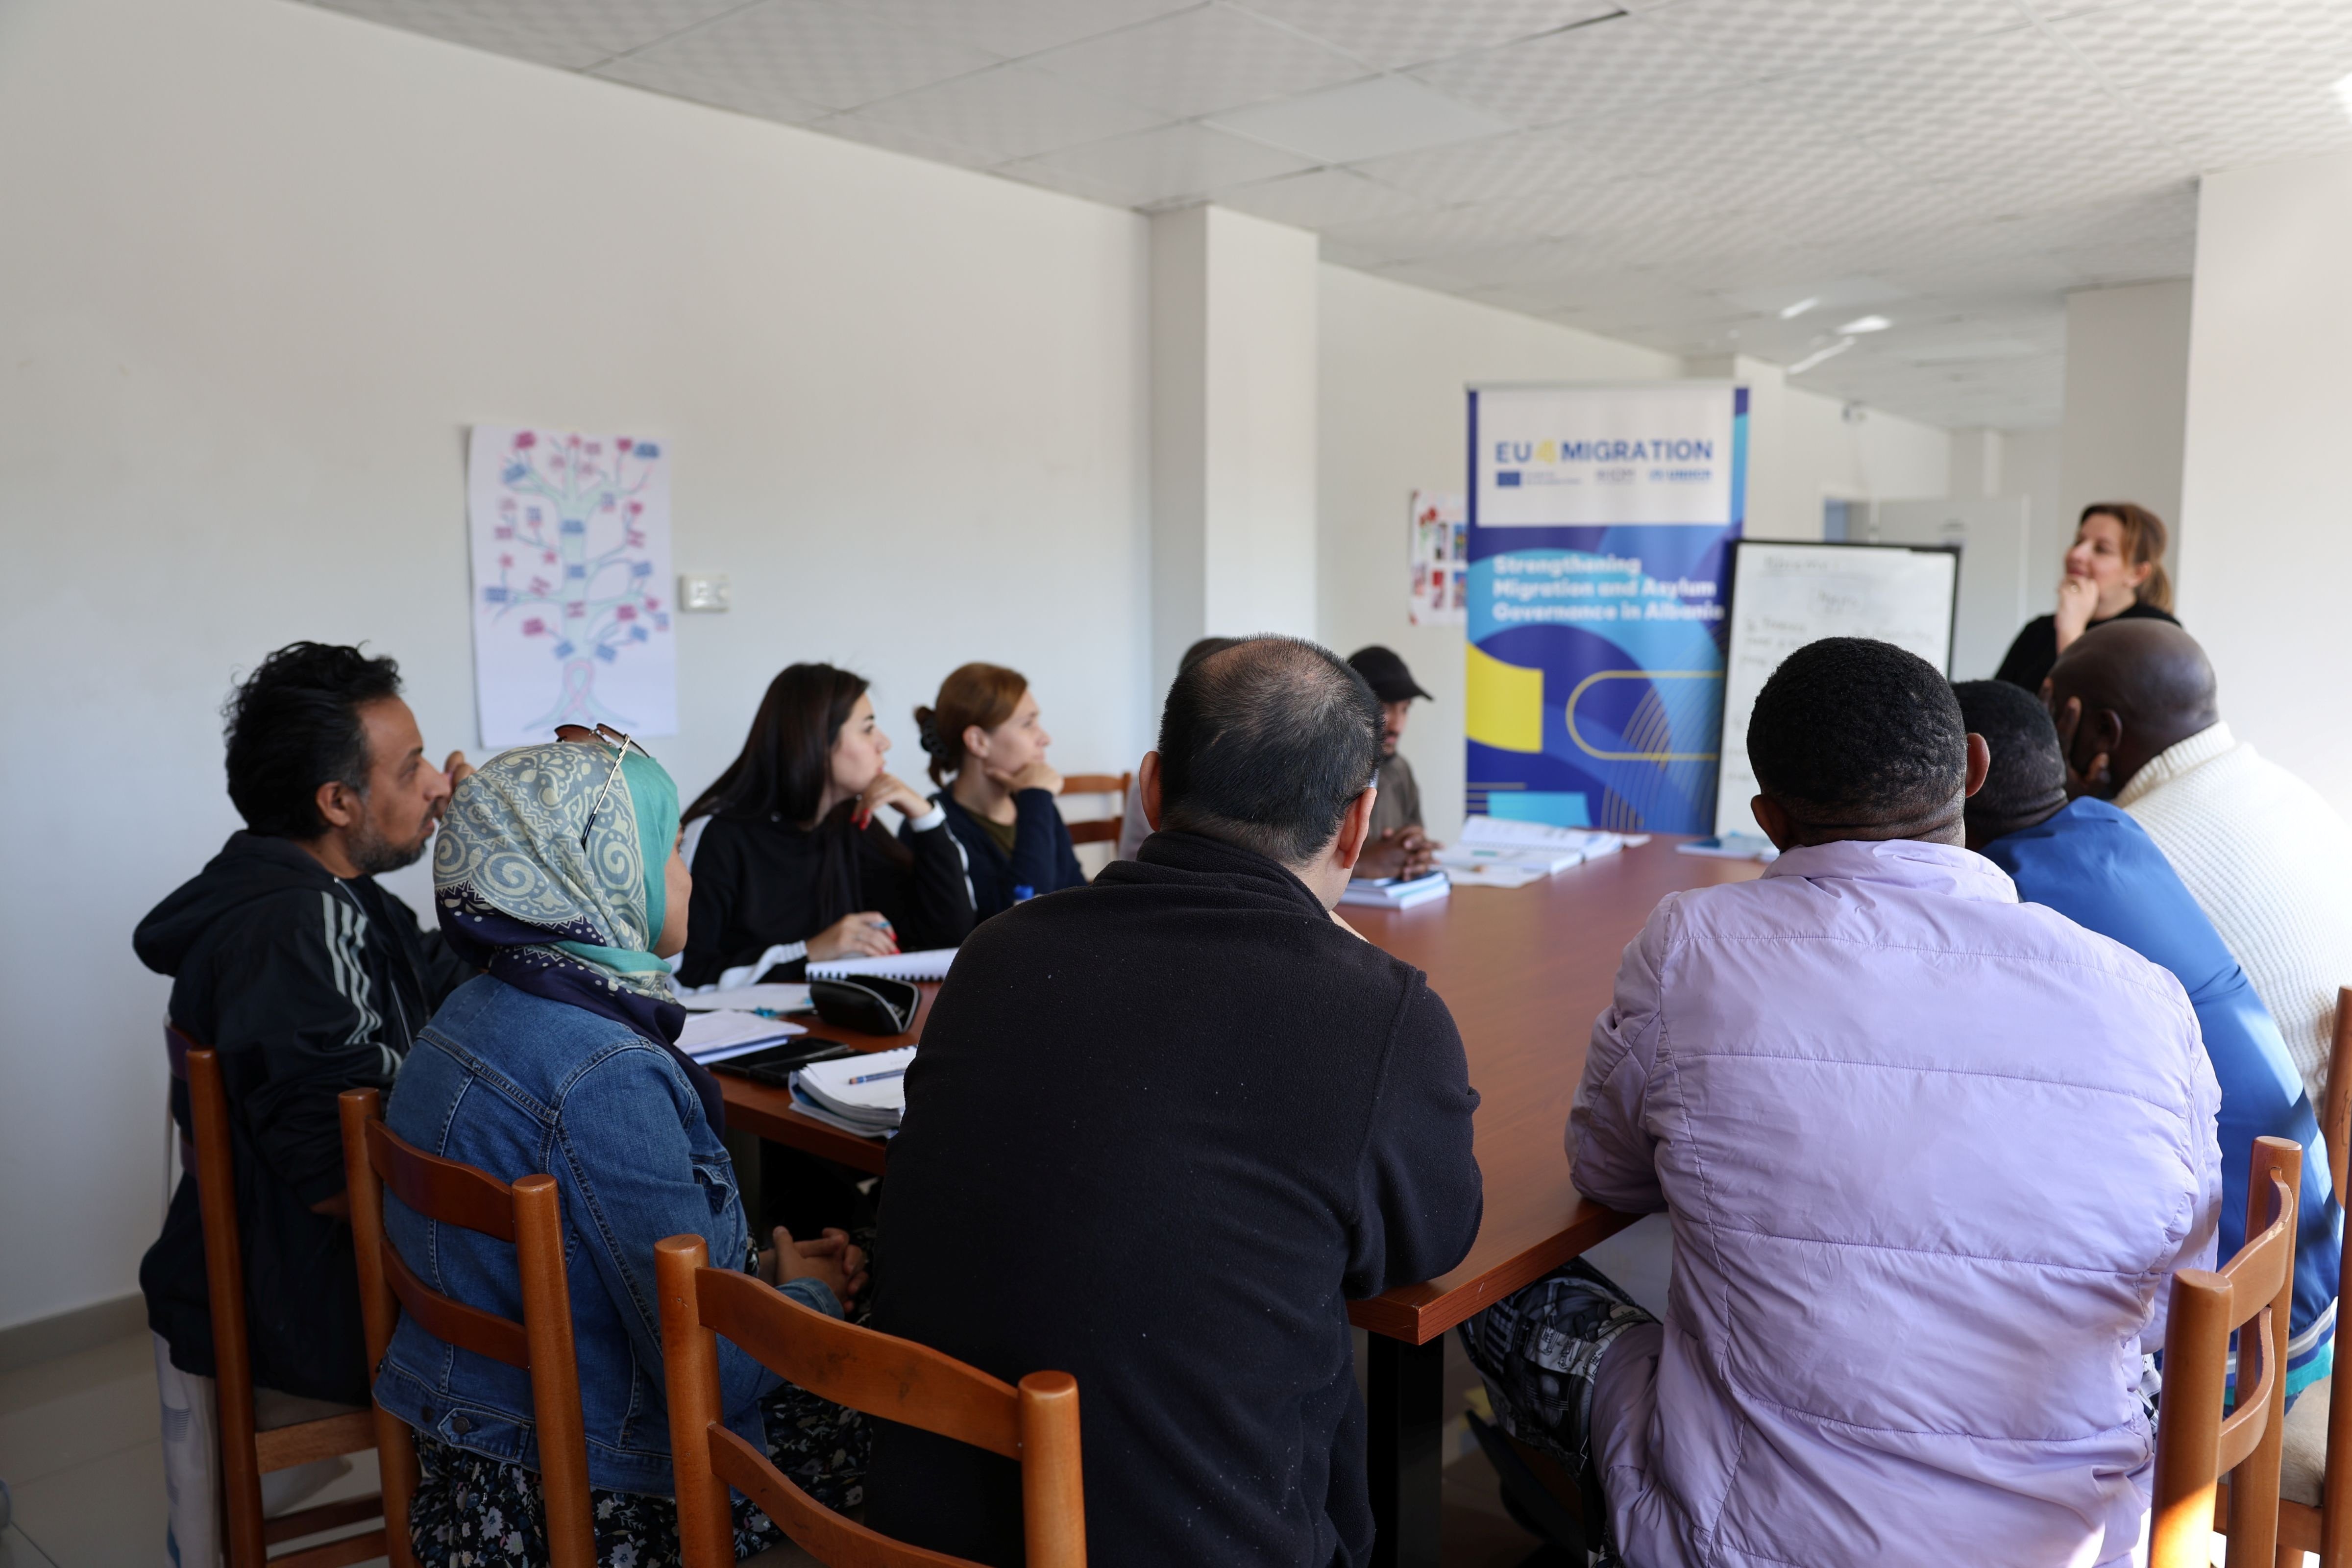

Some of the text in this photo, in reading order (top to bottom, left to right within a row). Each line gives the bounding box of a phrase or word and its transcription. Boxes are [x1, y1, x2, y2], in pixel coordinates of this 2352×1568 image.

[1494, 554, 1641, 576] Strengthening
[1494, 578, 1716, 600] Migration and Asylum
[1493, 602, 1724, 621] Governance in Albania
